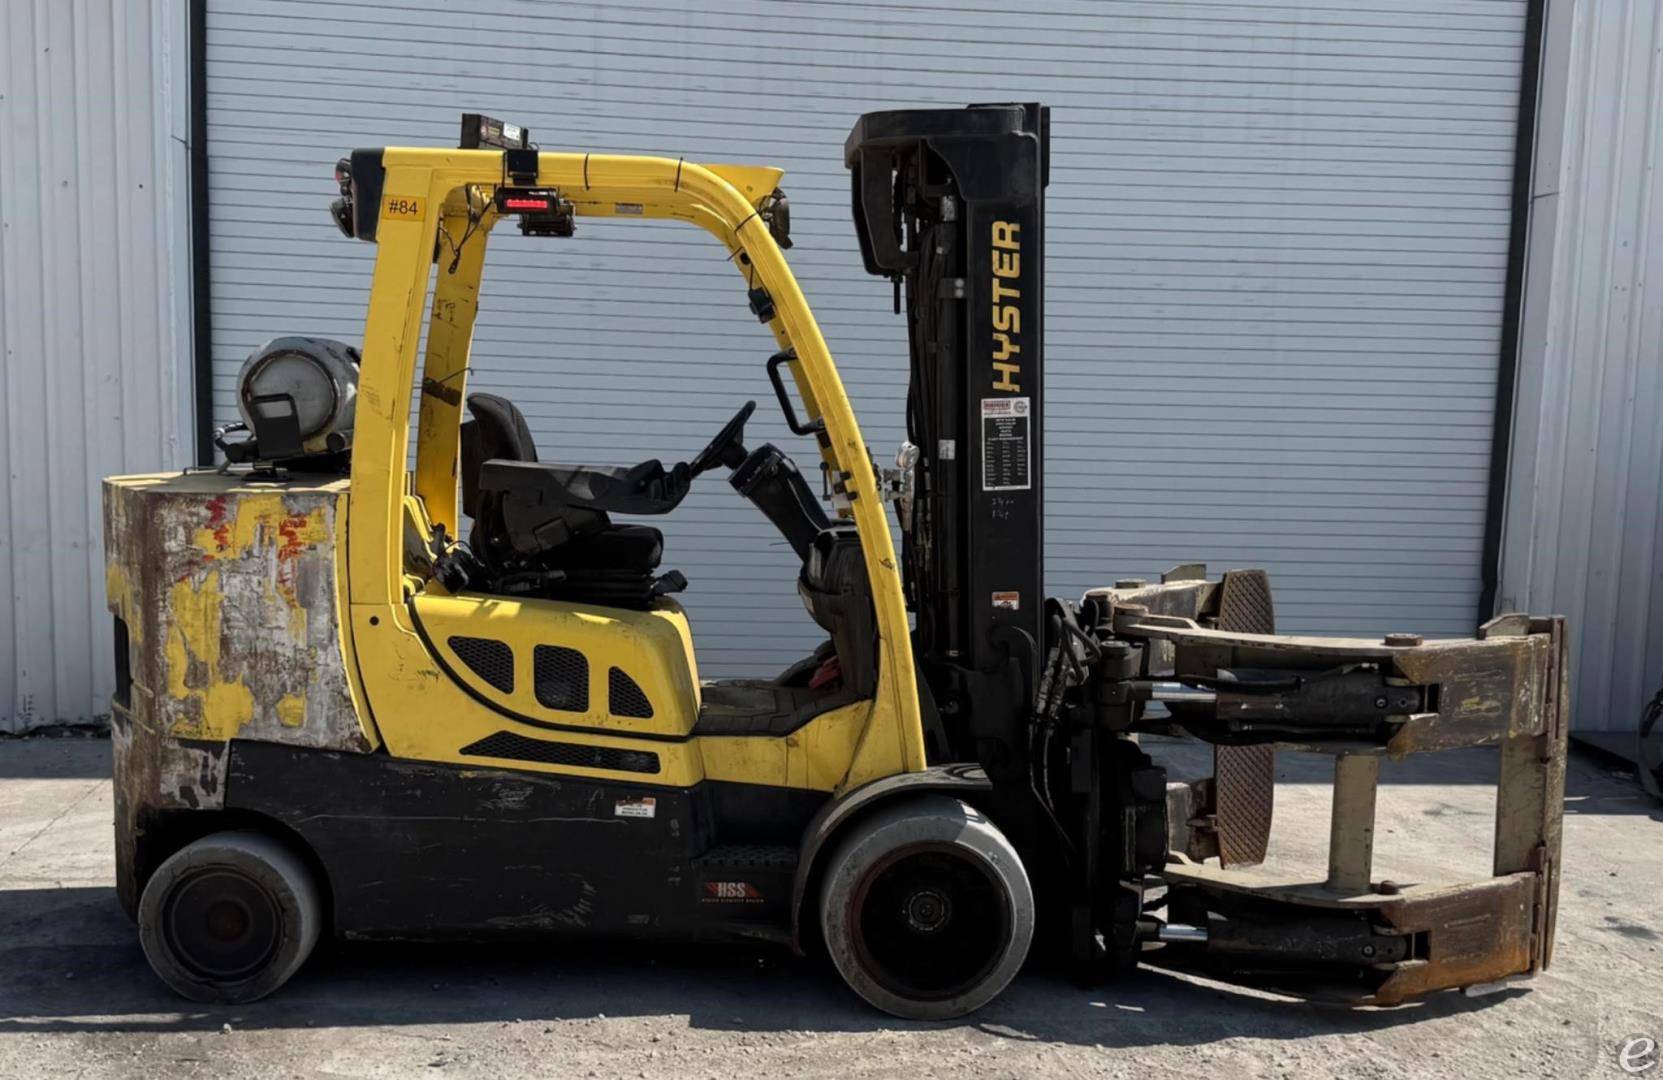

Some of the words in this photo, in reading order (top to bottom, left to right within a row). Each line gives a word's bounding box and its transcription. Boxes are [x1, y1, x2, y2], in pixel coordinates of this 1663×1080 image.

[388, 199, 419, 216] #84
[992, 220, 1021, 393] HYSTER
[717, 881, 746, 898] HSS
